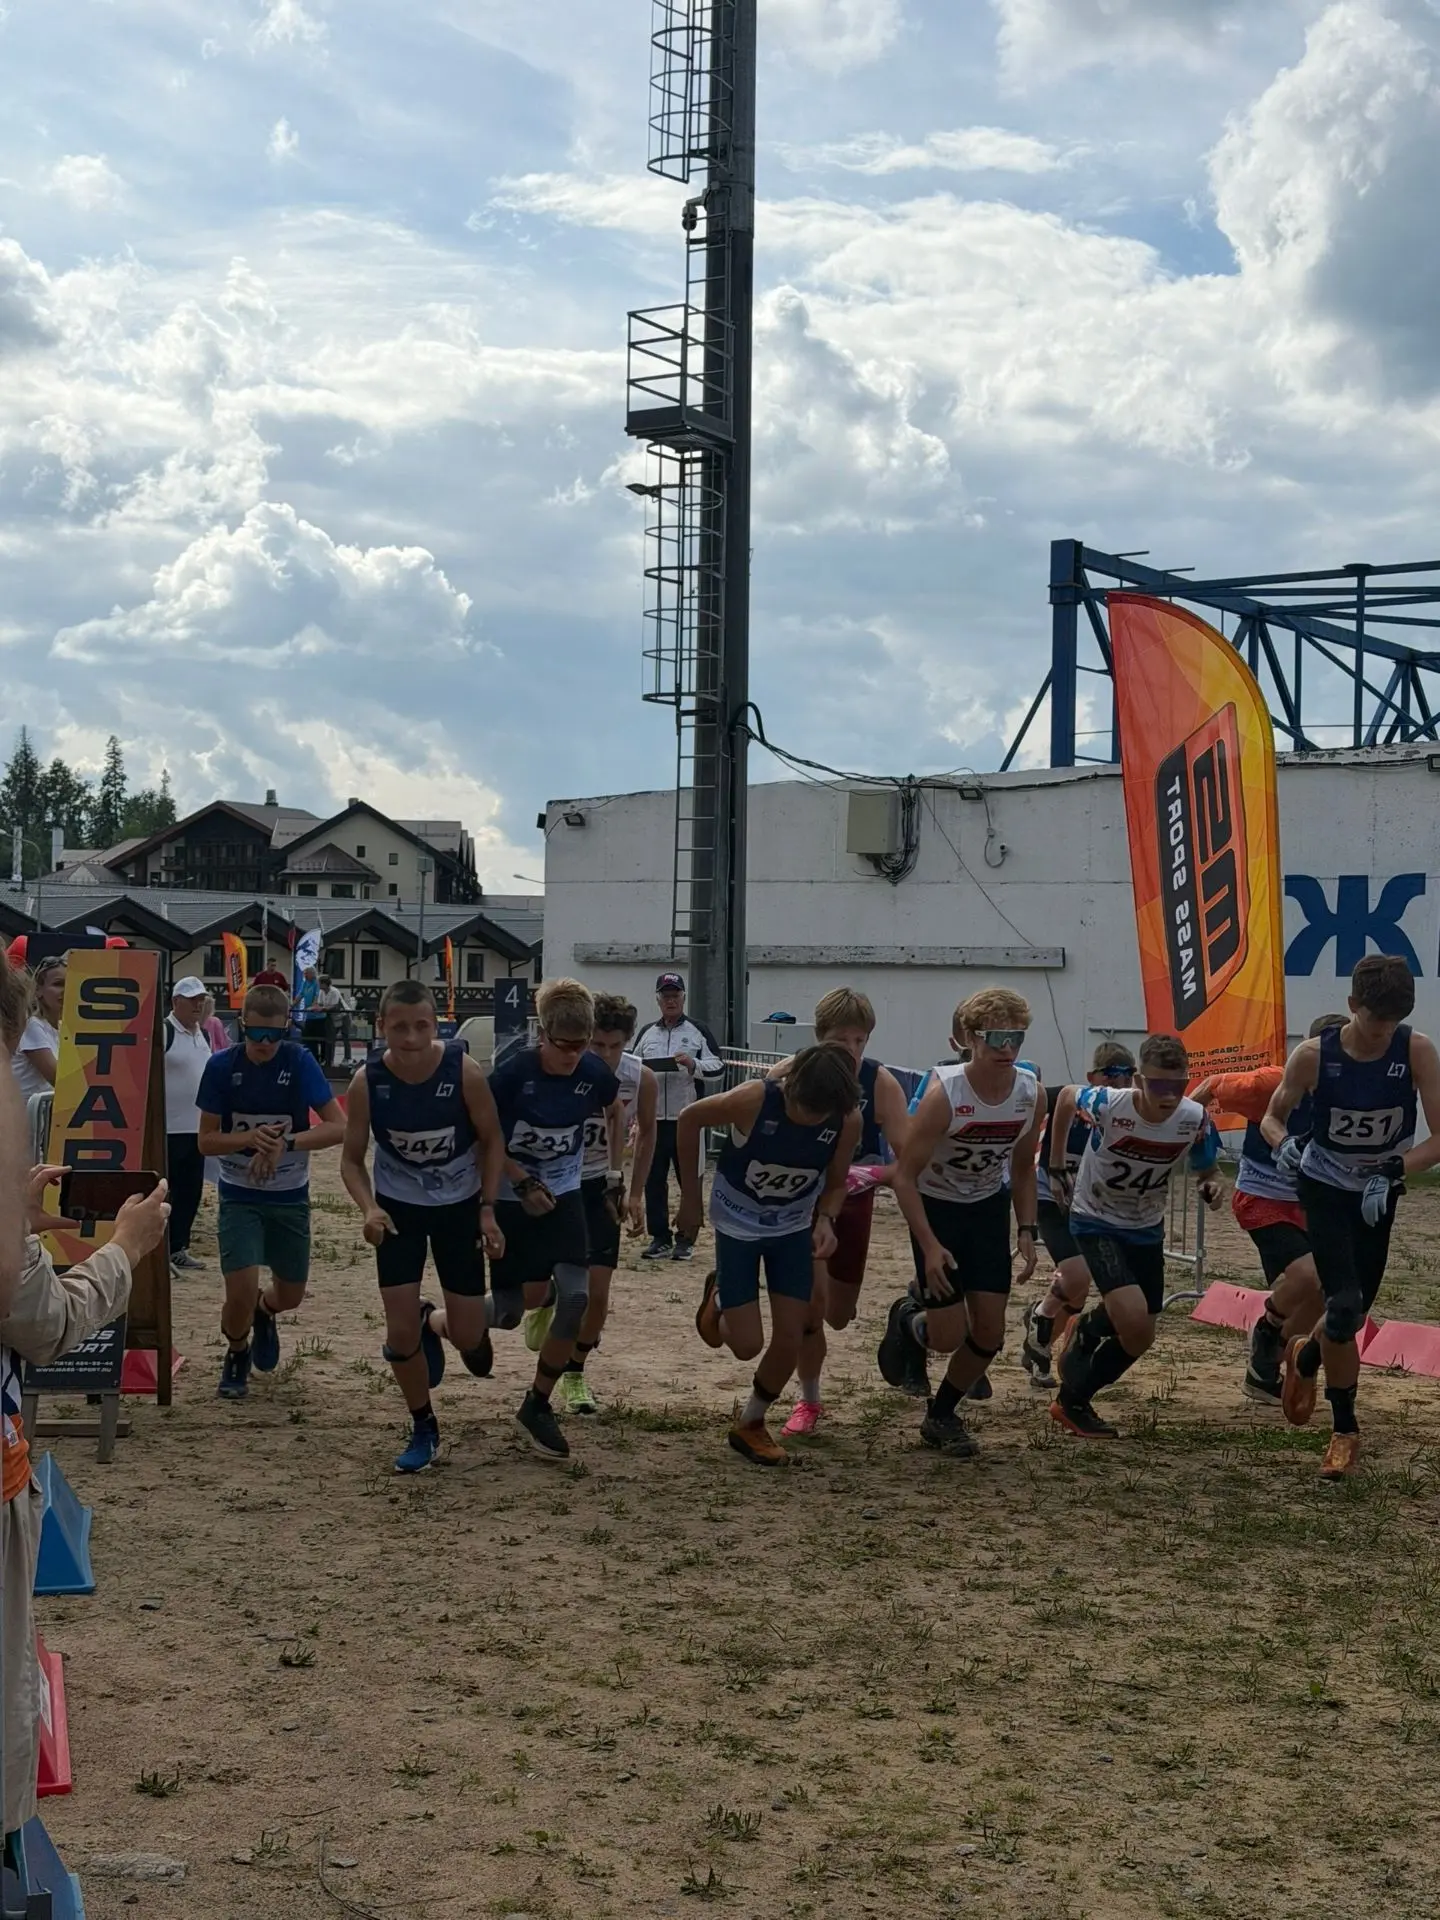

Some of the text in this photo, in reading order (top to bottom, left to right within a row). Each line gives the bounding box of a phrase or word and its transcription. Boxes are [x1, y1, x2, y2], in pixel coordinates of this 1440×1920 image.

[1285, 872, 1440, 978] Ж
[504, 984, 520, 1009] 4
[62, 977, 140, 1238] STAR
[1335, 1114, 1393, 1138] 251
[752, 1171, 809, 1193] 249
